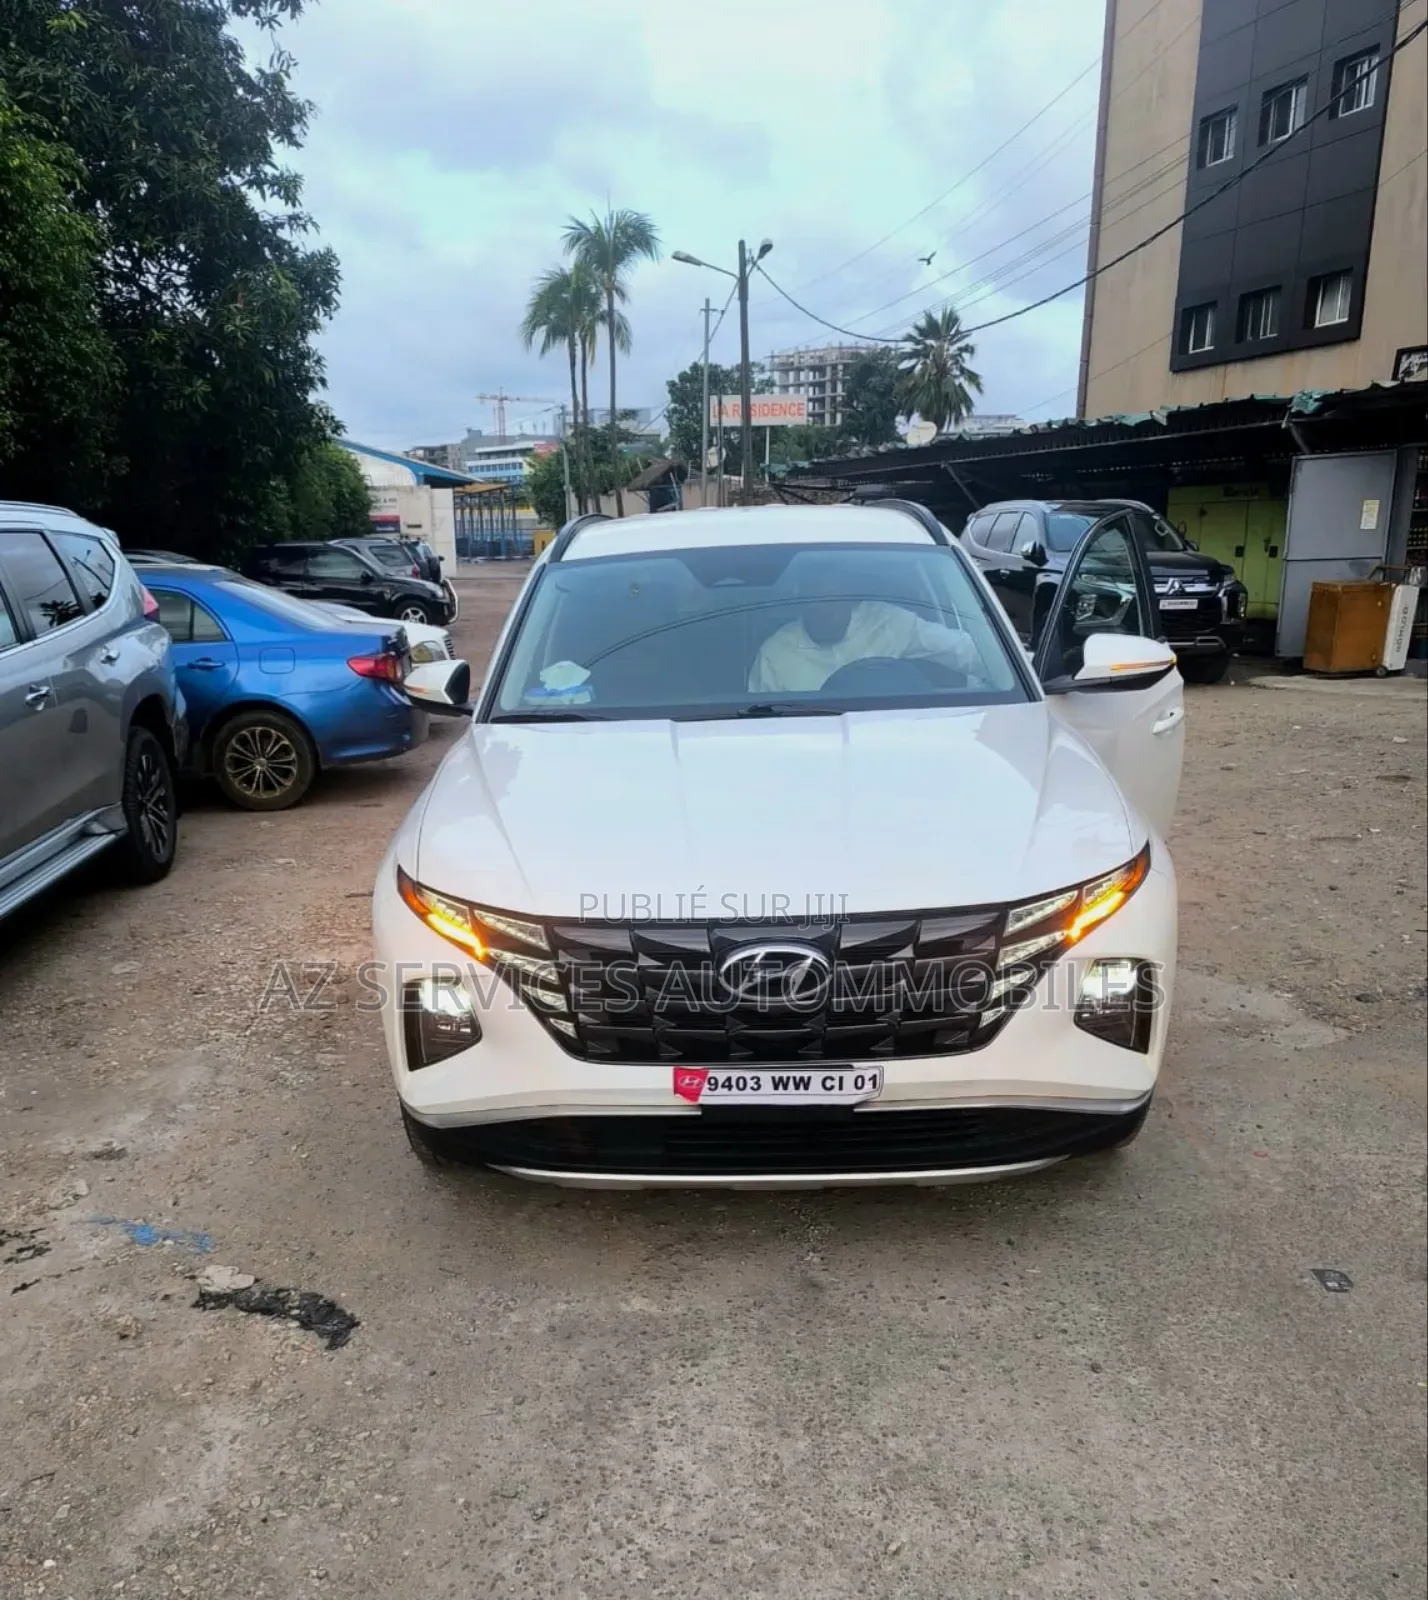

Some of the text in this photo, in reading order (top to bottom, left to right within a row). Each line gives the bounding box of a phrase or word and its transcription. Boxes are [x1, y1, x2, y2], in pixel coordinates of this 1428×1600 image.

[732, 401, 805, 418] RSIDENCE
[707, 1074, 878, 1092] 9403 WW CI 01
